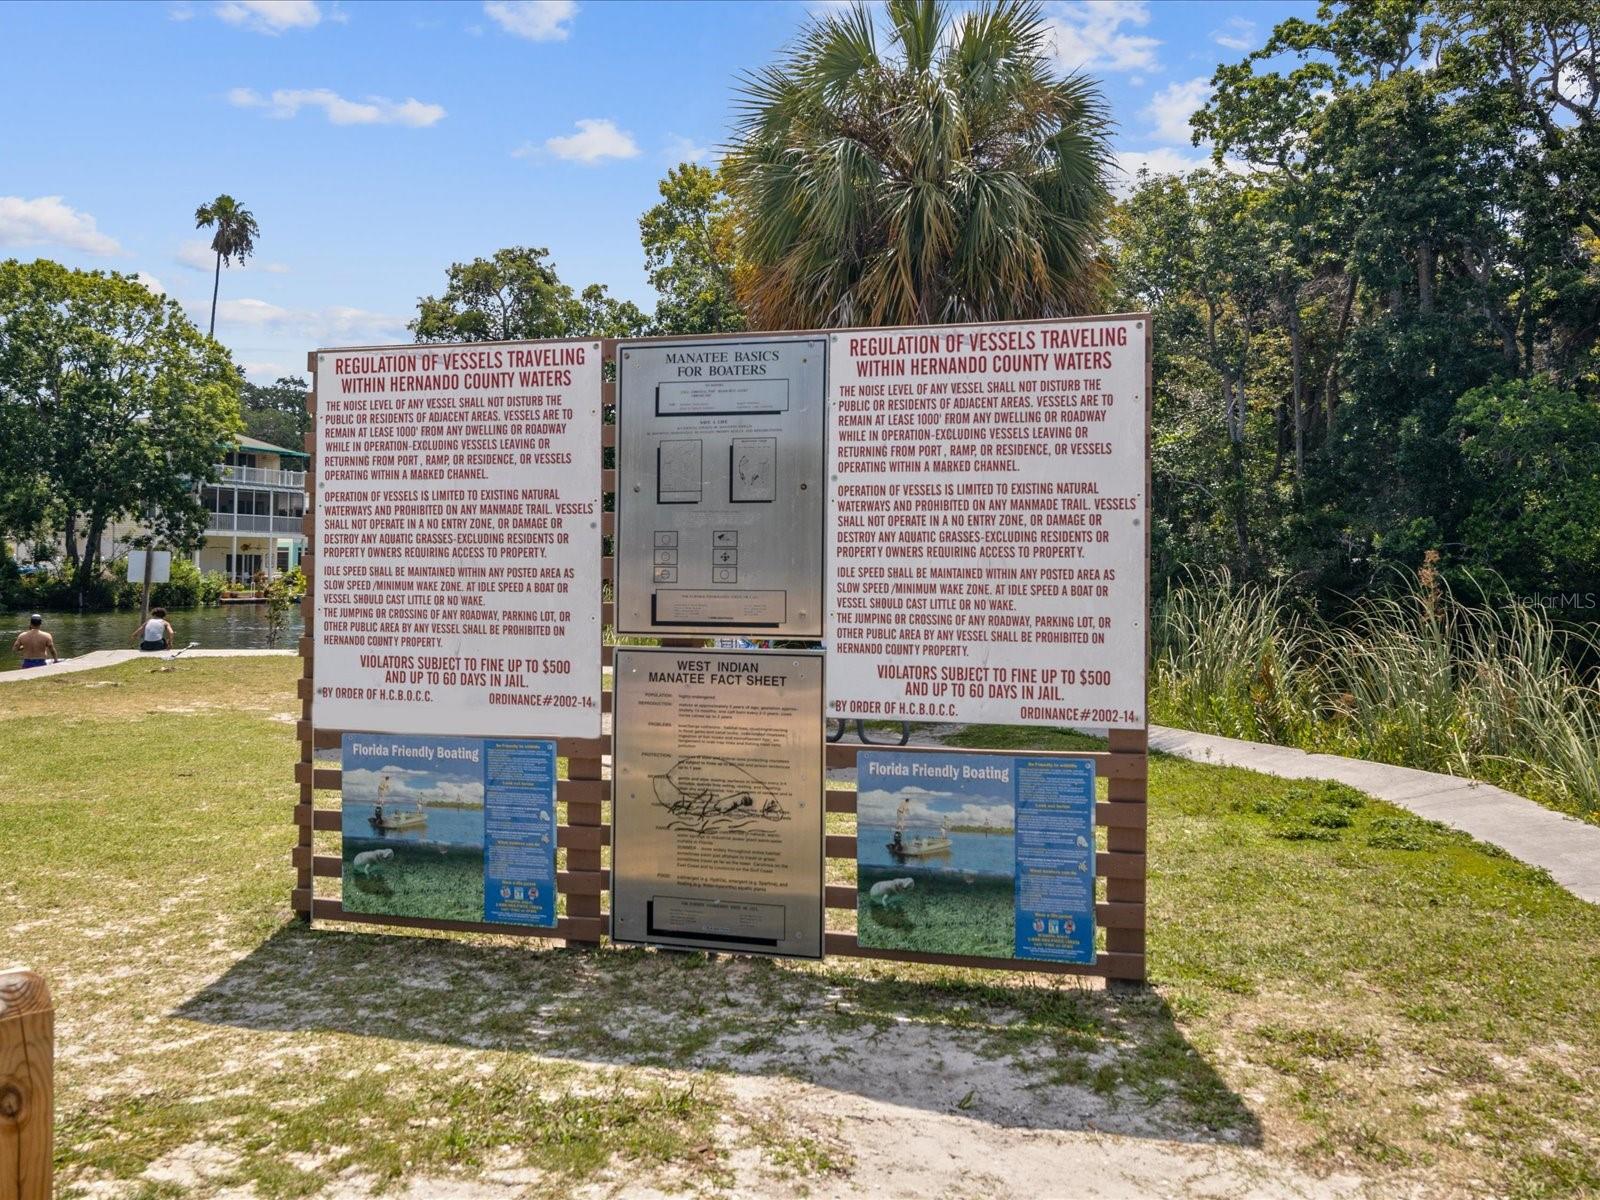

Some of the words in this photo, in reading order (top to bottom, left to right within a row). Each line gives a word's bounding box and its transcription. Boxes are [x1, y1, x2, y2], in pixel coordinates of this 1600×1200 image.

[849, 334, 939, 357] REGULATION
[945, 333, 966, 353] OF
[968, 330, 1036, 352] VESSELS
[1039, 326, 1127, 349] TRAVELING
[335, 354, 416, 375] REGULATION
[421, 354, 439, 372] OF
[442, 350, 503, 370] VESSELS
[506, 347, 585, 368] TRAVELING
[666, 352, 729, 364] MANATEE
[734, 350, 779, 362] BASICS
[856, 359, 905, 378] WITHIN
[910, 355, 987, 376] HERNANDO
[992, 353, 1050, 373] COUNTY
[1053, 350, 1112, 371] WATERS
[677, 366, 702, 377] FOR
[709, 364, 767, 376] BOATERS
[340, 376, 385, 394] WITHIN
[390, 373, 459, 392] HERNANDO
[463, 371, 516, 390] COUNTY
[518, 369, 572, 388] WATERS
[324, 414, 354, 425] PUBLIC
[356, 413, 367, 424] OR
[369, 412, 414, 424] RESIDENTS
[416, 412, 427, 423] OF
[428, 411, 470, 422] ADJACENT
[471, 410, 501, 422] AREAS.
[504, 409, 540, 421] VESSELS
[542, 408, 560, 420] ARE
[562, 408, 573, 420] TO
[838, 414, 872, 426] REMAIN
[874, 414, 886, 425] AT
[888, 413, 914, 426] LEASE
[944, 412, 970, 424] FROM
[972, 412, 992, 424] ANY
[994, 411, 1041, 423] DWELLING
[1044, 410, 1057, 423] OR
[1060, 409, 1107, 422] ROADWAY
[325, 441, 350, 452] WHILE
[352, 441, 361, 452] IN
[460, 439, 497, 450] VESSELS
[499, 438, 535, 450] LEAVING
[538, 438, 550, 449] OR
[837, 461, 886, 473] OPERATING
[888, 461, 921, 473] WITHIN
[923, 460, 930, 472] A
[932, 460, 971, 472] MARKED
[973, 459, 1019, 473] CHANNEL.
[324, 490, 368, 502] OPERATION
[370, 490, 382, 502] OF
[382, 490, 418, 501] VESSELS
[420, 489, 429, 501] IS
[431, 489, 465, 501] LIMITED
[466, 489, 478, 501] TO
[480, 488, 519, 500] EXISTING
[521, 488, 561, 500] NATURAL
[836, 500, 890, 512] WATERWAYS
[893, 499, 912, 511] AND
[915, 499, 969, 511] PROHIBITED
[972, 499, 986, 511] ON
[988, 499, 1007, 511] ANY
[1009, 498, 1058, 510] MANMADE
[1061, 498, 1091, 511] TRAIL.
[1094, 497, 1136, 510] VESSELS
[323, 533, 360, 544] DESTROY
[360, 533, 378, 544] ANY
[379, 533, 413, 544] AQUATIC
[507, 532, 554, 544] RESIDENTS
[556, 532, 569, 544] OR
[836, 546, 884, 557] PROPERTY
[885, 546, 924, 558] OWNERS
[926, 546, 976, 558] REQUIRING
[979, 546, 1015, 558] ACCESS
[1018, 546, 1030, 558] TO
[1032, 546, 1086, 559] PROPERTY.
[836, 596, 867, 608] VESSEL
[869, 597, 903, 609] SHOULD
[905, 598, 928, 610] CAST
[929, 598, 957, 610] LITTLE
[958, 599, 971, 610] OR
[973, 599, 986, 610] NO
[988, 599, 1017, 611] WAKE.
[836, 642, 882, 654] HERNANDO
[884, 643, 920, 655] COUNTY
[922, 644, 970, 657] PROPERTY.
[359, 654, 414, 669] VIOLATORS
[417, 656, 462, 670] SUBJECT
[463, 657, 477, 671] TO
[480, 657, 505, 672] FINE
[507, 658, 522, 672] UP
[524, 659, 539, 674] TO
[542, 658, 570, 674] $500
[677, 661, 711, 672] WEST
[717, 662, 759, 673] INDIAN
[648, 672, 705, 684] MANATEE
[710, 674, 742, 685] FACT
[746, 675, 787, 687] SHEET
[321, 686, 333, 698] BY
[334, 686, 364, 700] ORDER
[366, 688, 378, 700] OF
[904, 681, 928, 696] AND
[932, 682, 948, 697] UP
[952, 682, 965, 698] TO
[968, 683, 984, 698] 60
[988, 684, 1017, 700] DAYS
[1021, 685, 1034, 700] IN
[1037, 685, 1064, 701] JAIL.
[834, 699, 848, 712] BY
[849, 699, 881, 713] ORDER
[884, 702, 897, 714] OF
[352, 743, 389, 756] Florida
[392, 744, 434, 760] Friendly
[437, 747, 479, 763] Boating
[869, 762, 909, 776] Florida
[912, 763, 959, 780] Friendly
[962, 765, 1009, 783] Boating
